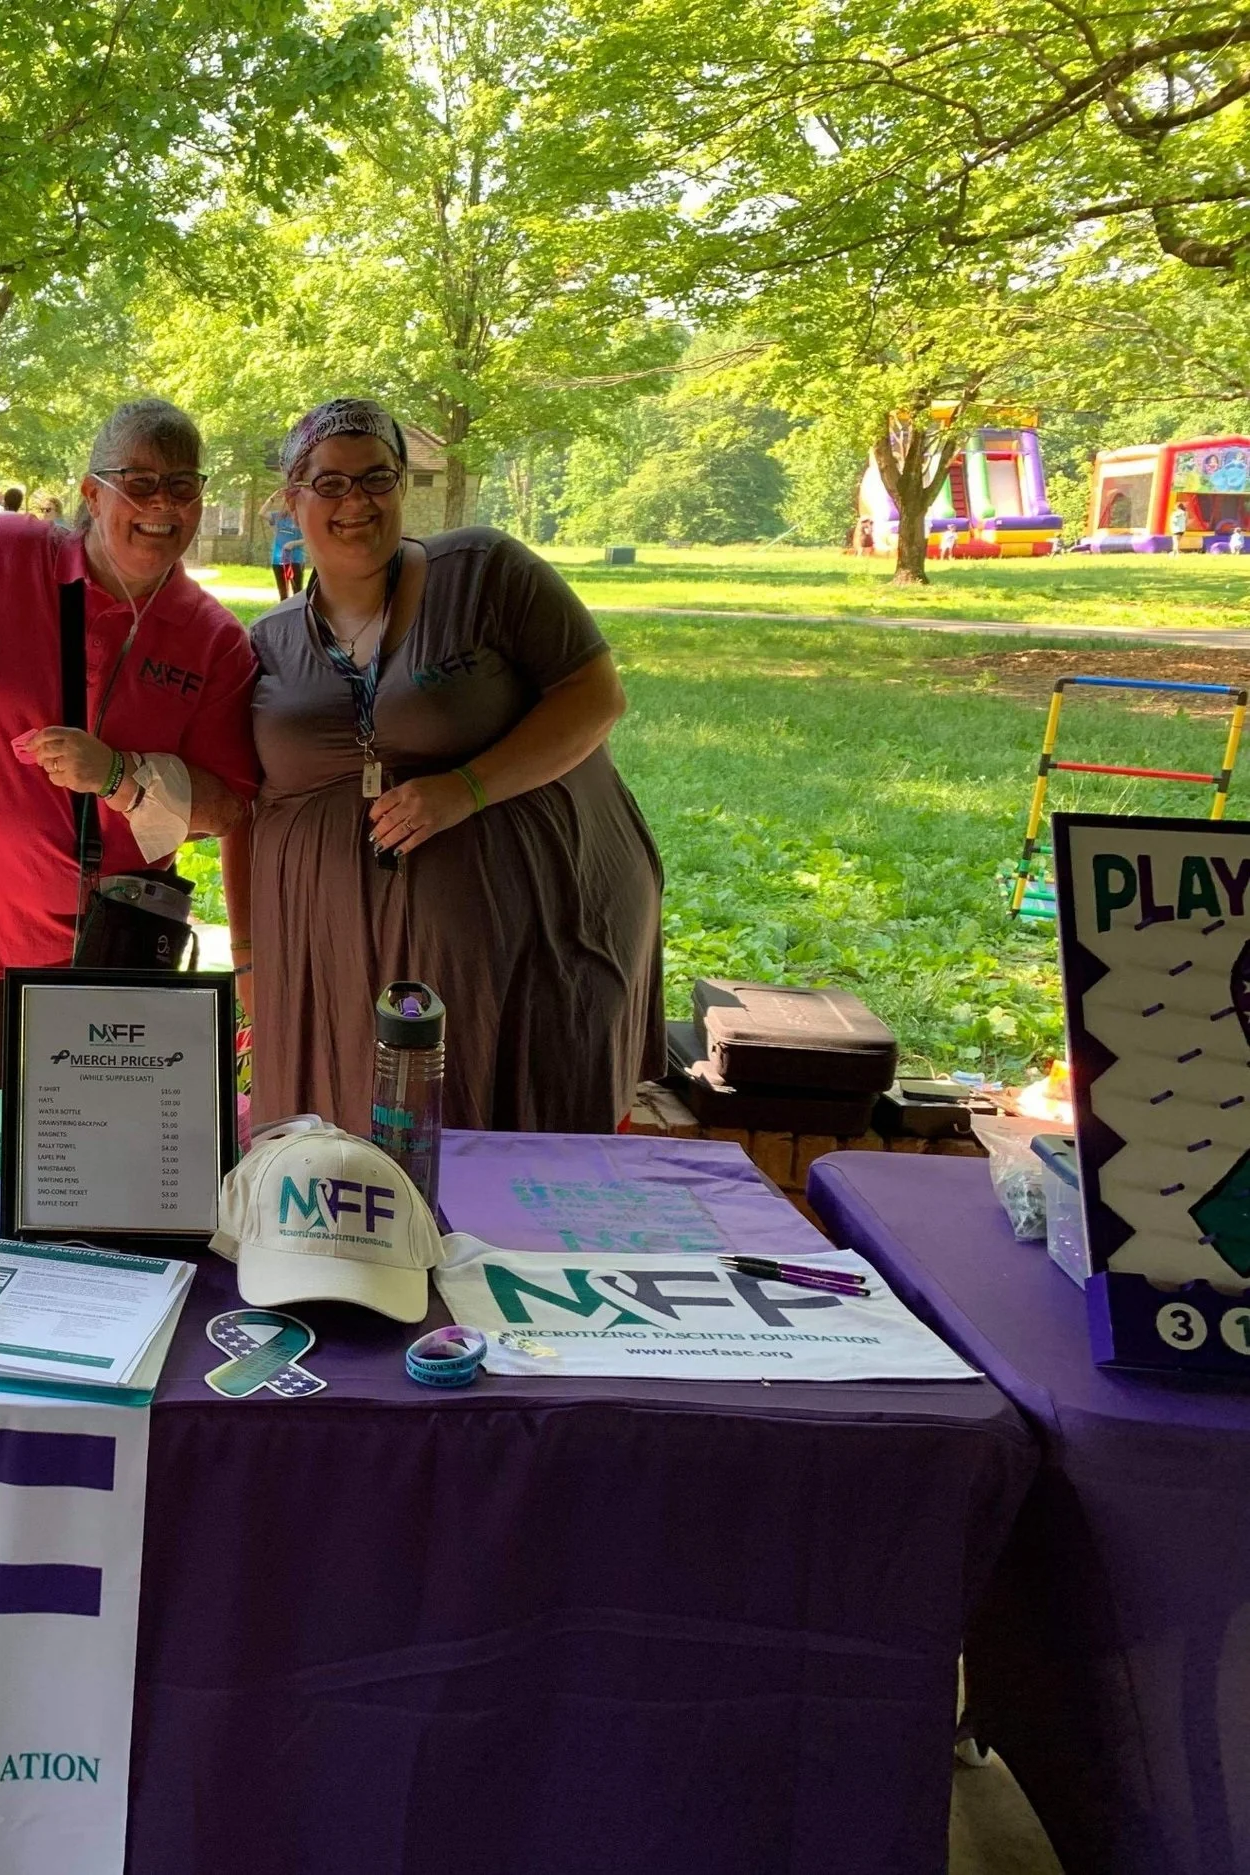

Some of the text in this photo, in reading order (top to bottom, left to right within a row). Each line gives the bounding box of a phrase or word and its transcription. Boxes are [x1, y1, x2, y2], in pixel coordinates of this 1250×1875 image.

[1093, 854, 1250, 934] PLAY
[70, 1054, 164, 1068] MERCH PRICES
[80, 1074, 103, 1082] (WHILE
[135, 1075, 155, 1083] LAST)
[356, 1235, 393, 1248] FOUNDATION
[51, 1245, 97, 1258] FASCIITIS
[100, 1252, 165, 1267] FOUNDATION
[1170, 1309, 1194, 1342] 3
[510, 1328, 882, 1345] NECROTIZING FASCIITIS FOUNDATION
[625, 1347, 793, 1360] www.necfasc.org
